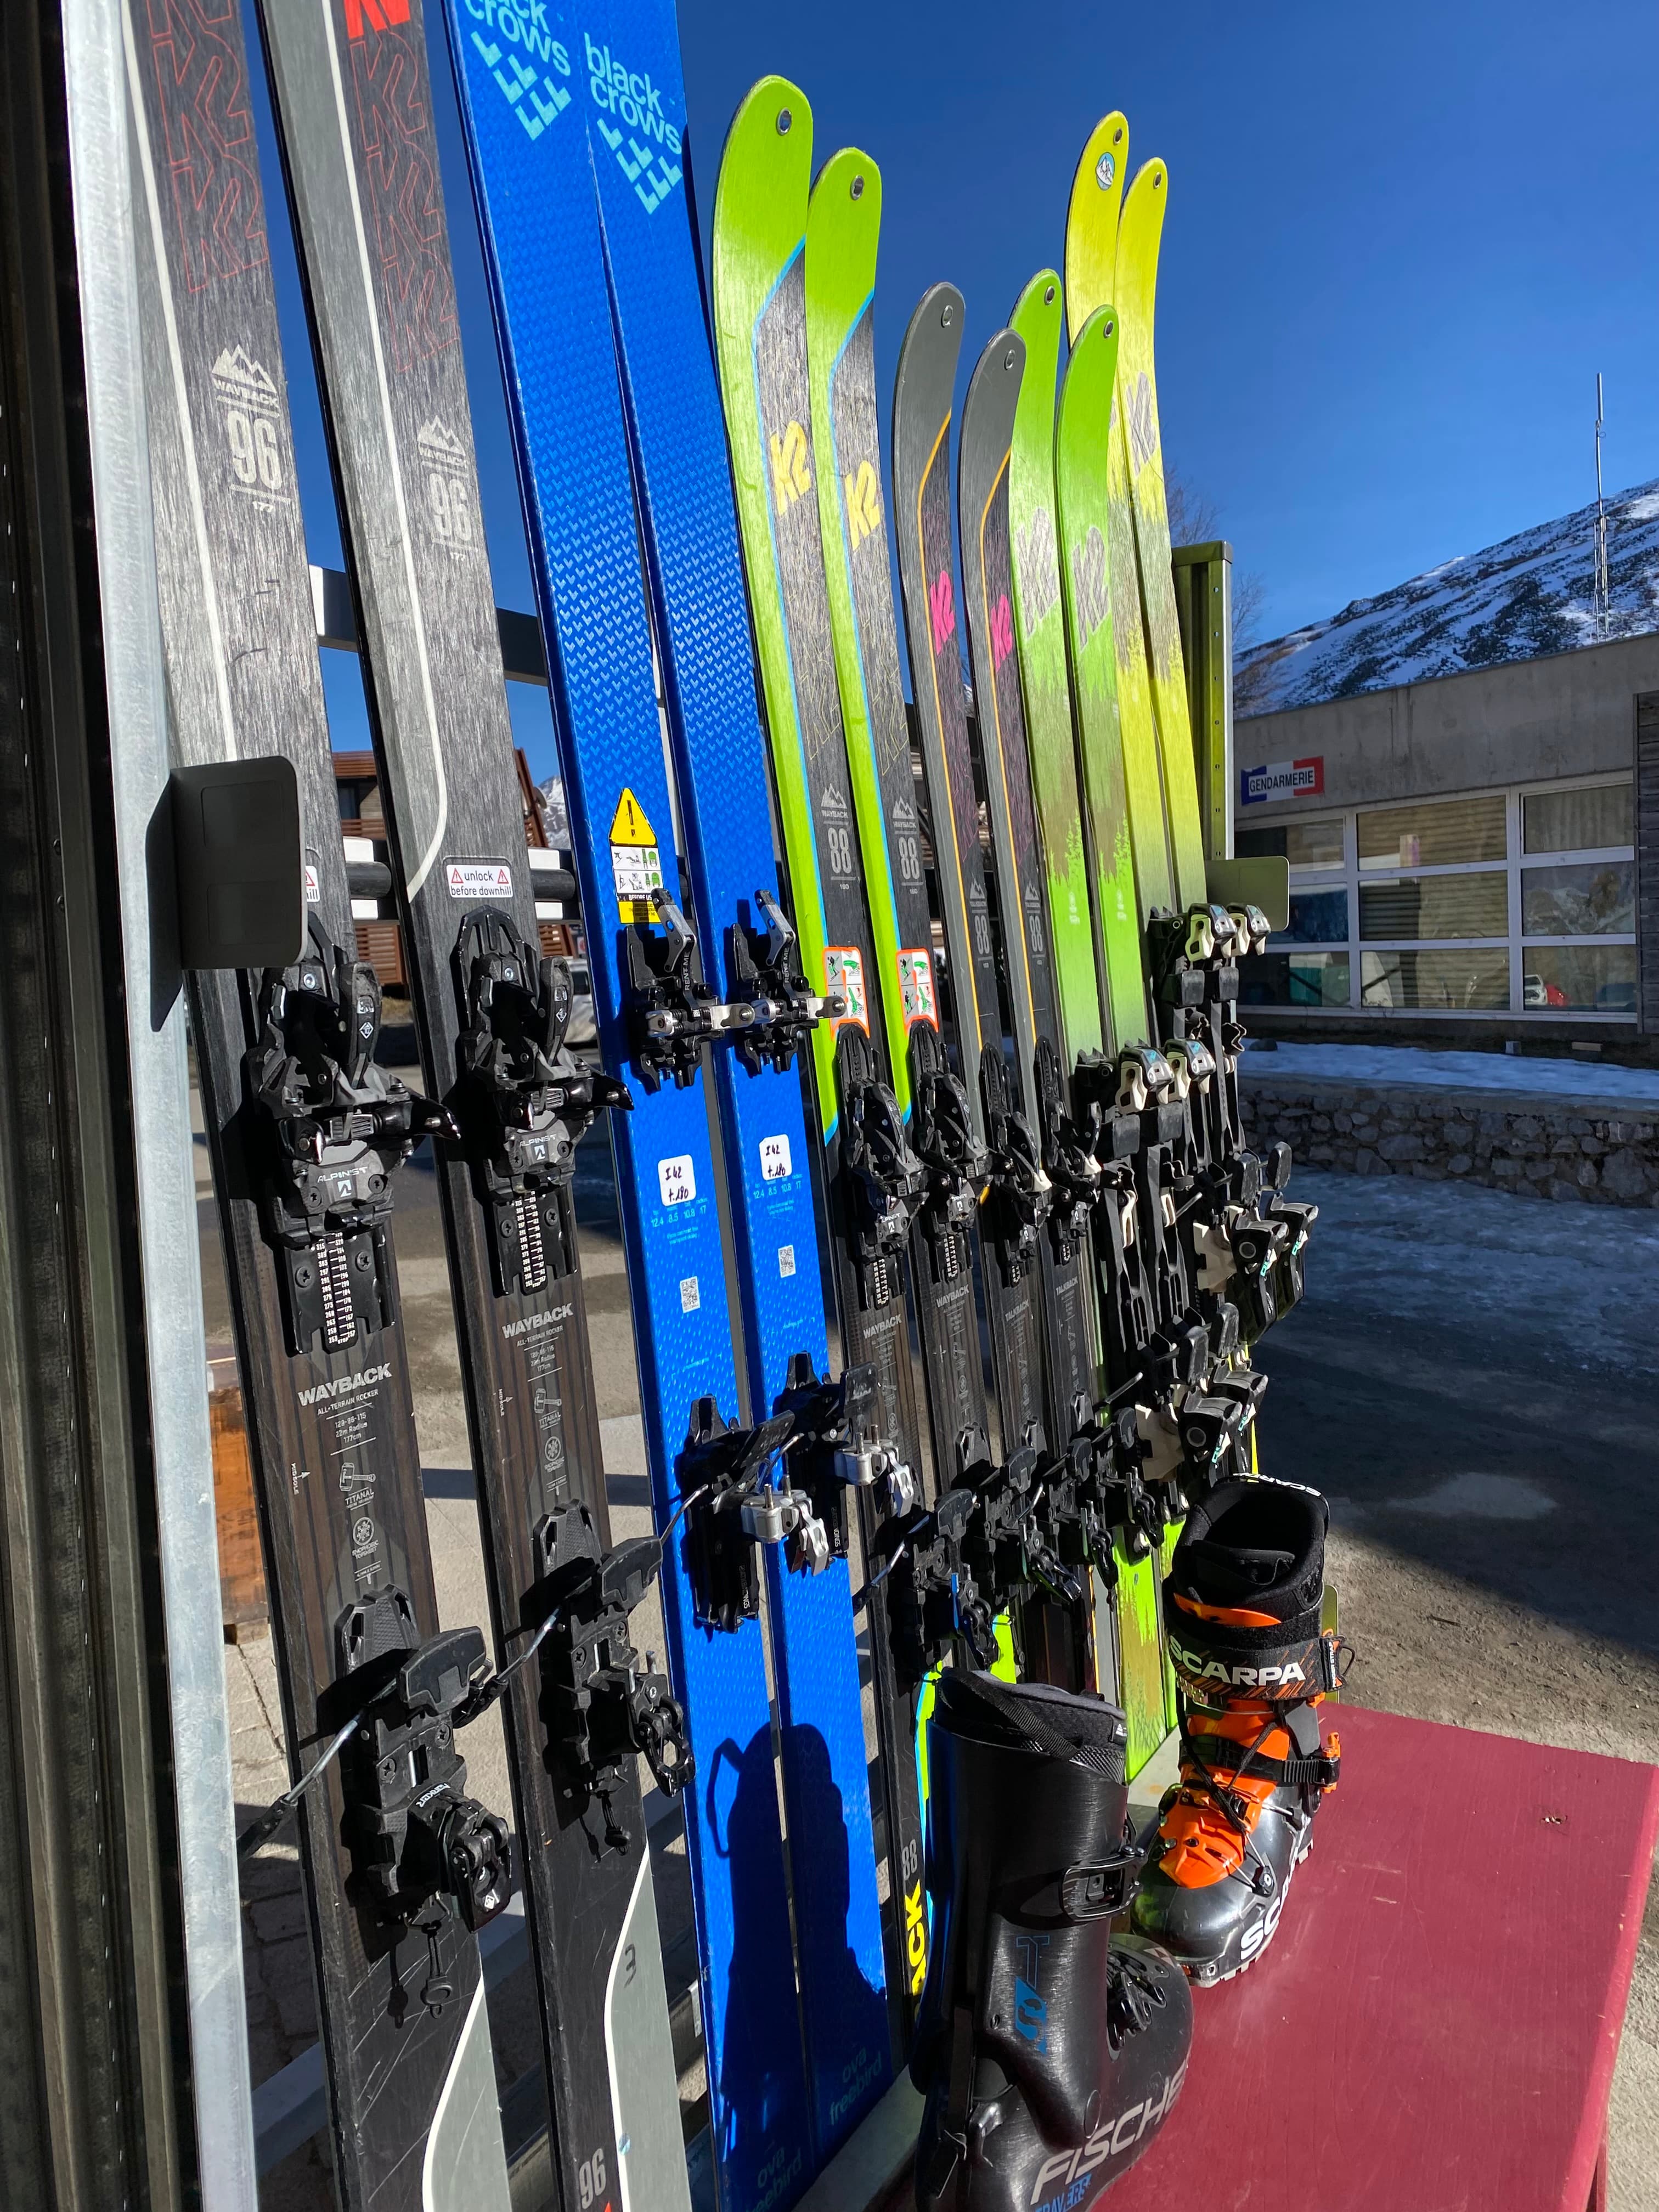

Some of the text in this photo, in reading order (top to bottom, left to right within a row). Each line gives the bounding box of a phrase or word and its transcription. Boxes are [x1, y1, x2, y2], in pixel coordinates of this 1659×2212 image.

[584, 32, 663, 118] black
[590, 75, 682, 155] crows
[212, 379, 280, 408] WAYBACK
[227, 410, 284, 490] 96
[770, 420, 811, 516] K2
[428, 473, 472, 541] 96
[845, 460, 881, 551] K2
[930, 570, 955, 656] K2
[991, 594, 1013, 673] K2
[1250, 770, 1314, 793] GENDARMERIE
[828, 827, 852, 874] 88
[899, 837, 920, 879] 88
[450, 884, 512, 897] before downhill
[464, 870, 494, 882] unlock
[974, 915, 990, 955] 88
[1029, 916, 1043, 952] 88
[683, 952, 690, 966] ME
[782, 947, 789, 961] ME
[753, 1180, 802, 1199] 12.4 8.5 10.8 17
[651, 1217, 664, 1228] 12.4
[668, 1212, 679, 1223] 8.5
[683, 1208, 696, 1219] 10.8
[700, 1205, 707, 1215] 17
[936, 1284, 970, 1308] WAYBACK
[1056, 1276, 1079, 1296] TALKBACK
[502, 1302, 573, 1339] WAYBACK
[863, 1313, 902, 1339] WAYBACK
[1005, 1299, 1029, 1322] TALKBACK
[297, 1362, 392, 1406] WAYBACK
[318, 1389, 379, 1415] ALL-TERRAIN ROCKER
[335, 1422, 368, 1438] 22m Radius
[343, 1432, 362, 1443] 177cm
[345, 1488, 375, 1505] TITANAL
[1169, 1635, 1306, 1686] SCARPA
[901, 1839, 918, 1882] 88
[830, 2050, 882, 2125] freebird
[1030, 2059, 1189, 2205] FISCHE
[579, 2148, 607, 2210] 96
